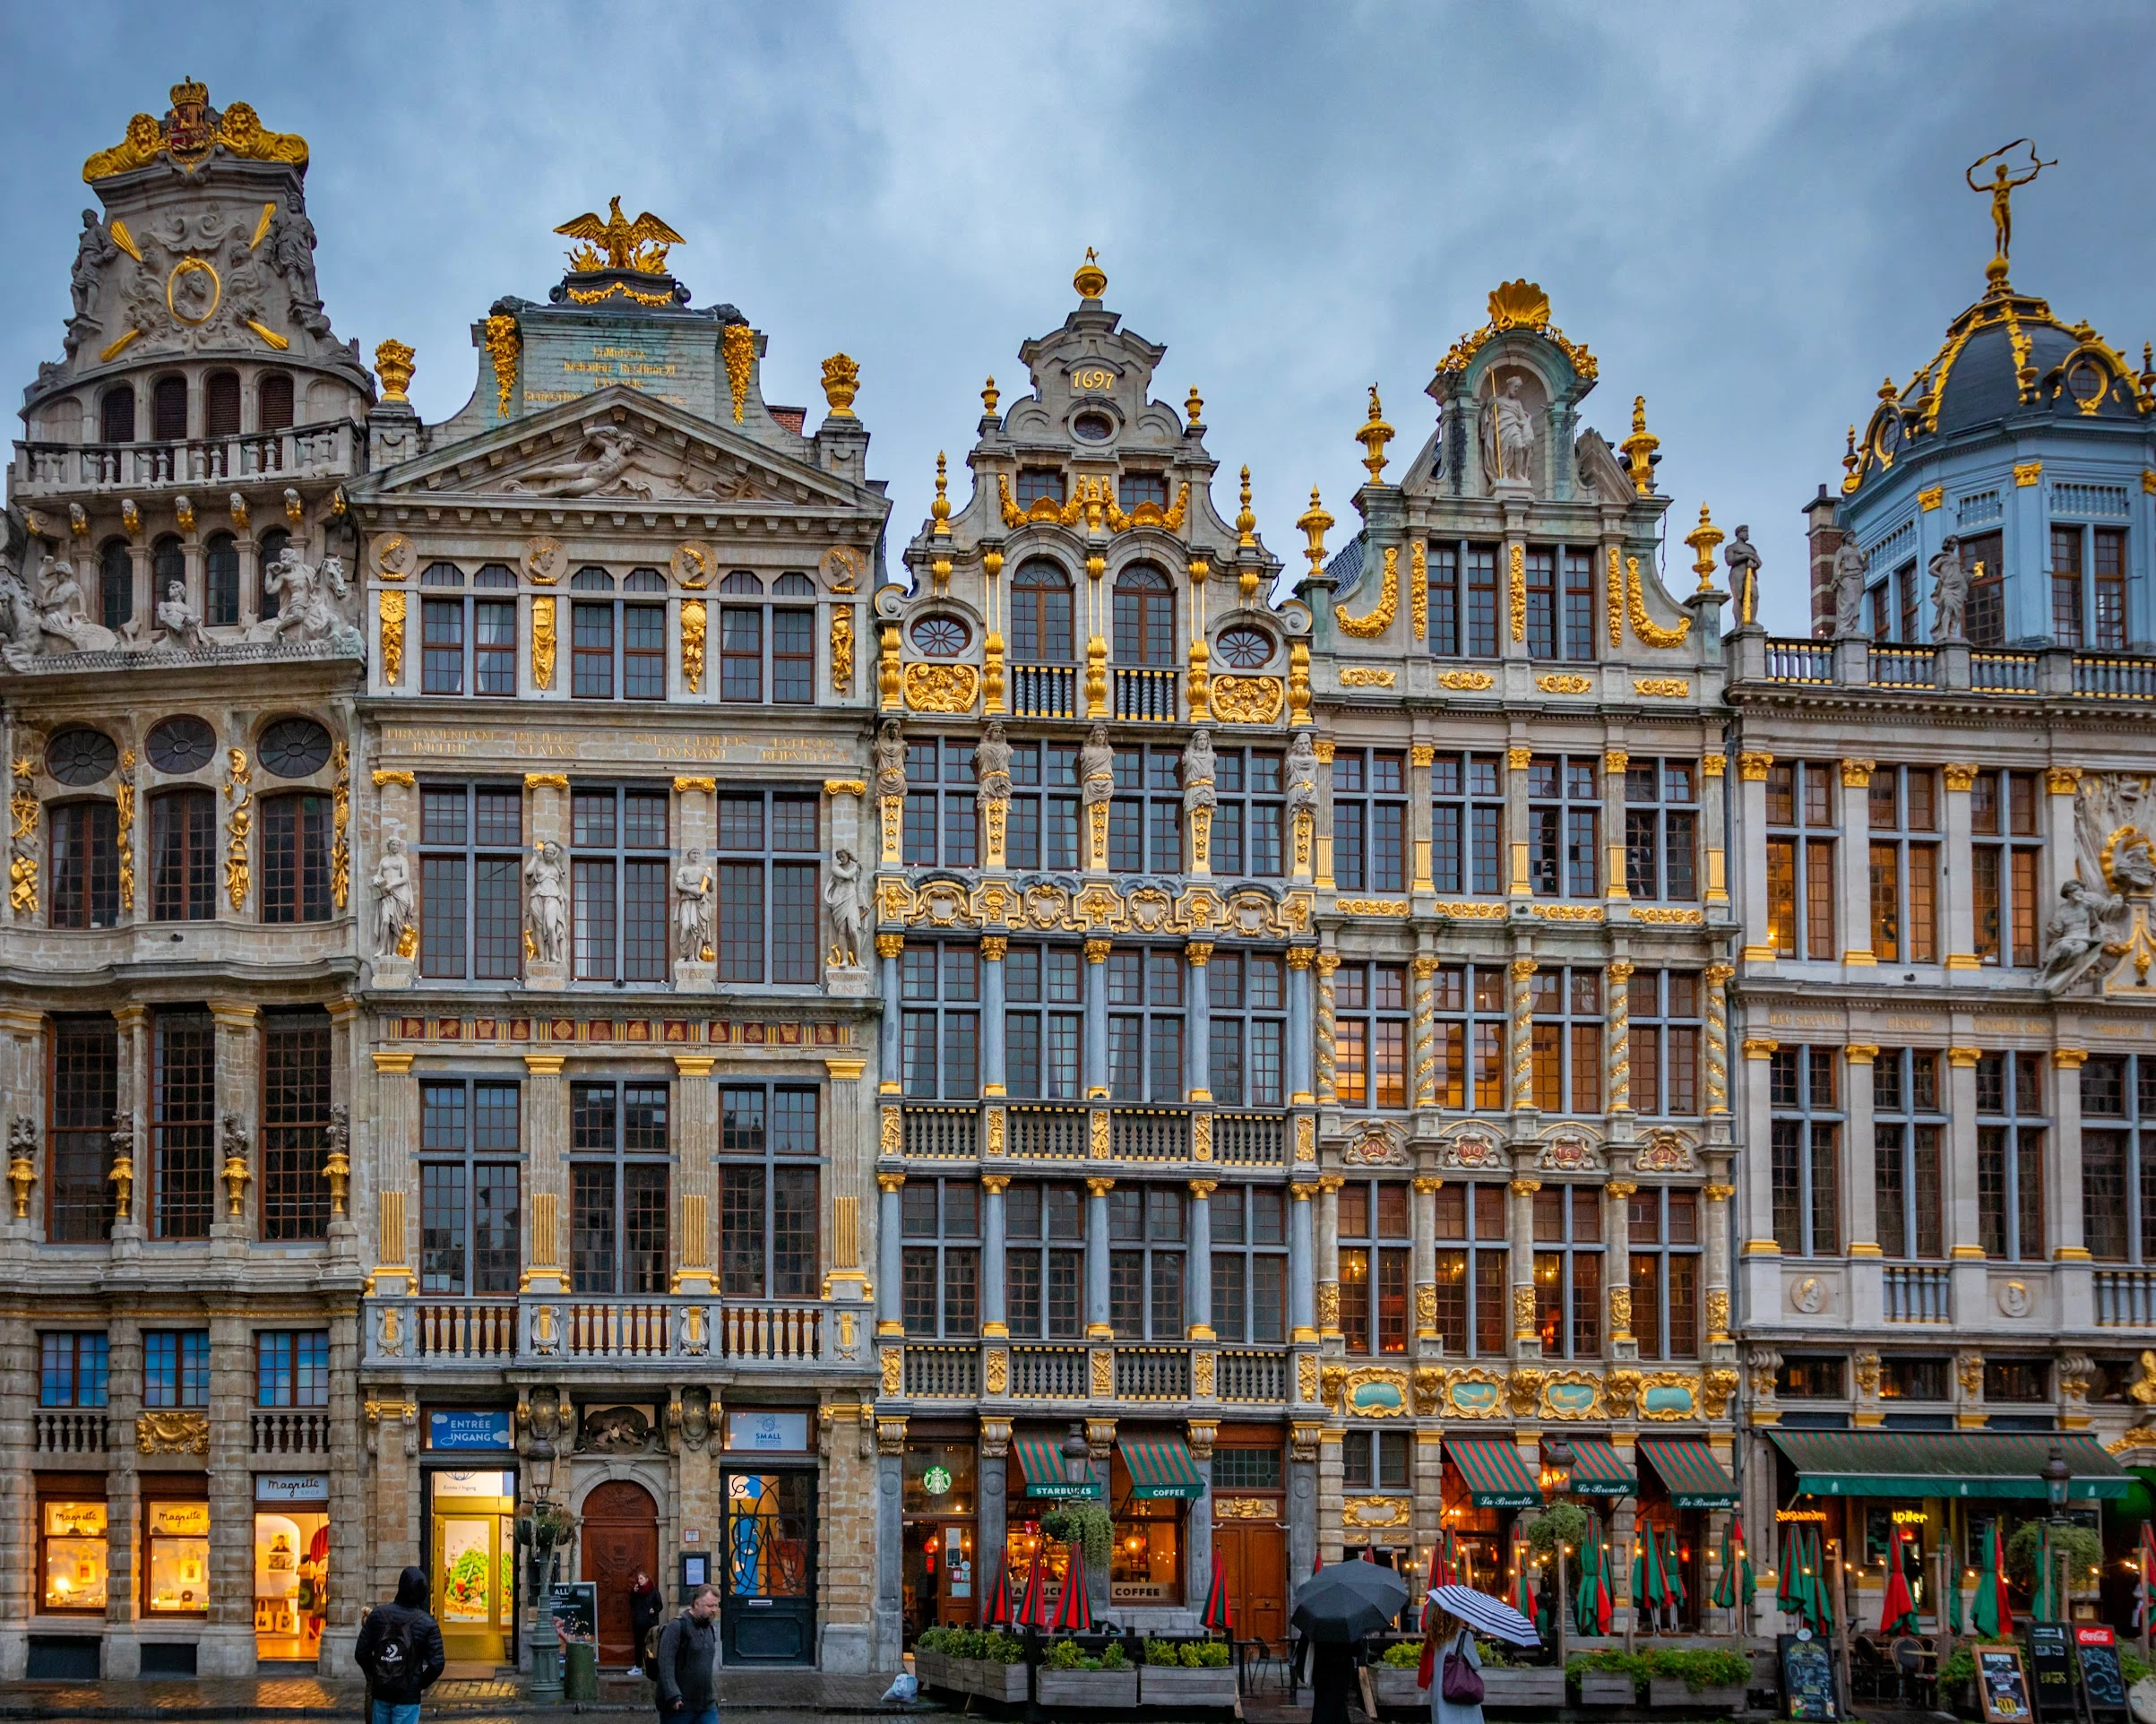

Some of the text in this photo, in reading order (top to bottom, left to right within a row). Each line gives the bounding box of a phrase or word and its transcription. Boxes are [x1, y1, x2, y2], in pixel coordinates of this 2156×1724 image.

[1073, 370, 1115, 390] 1697
[658, 747, 726, 760] HVMANI
[681, 969, 707, 978] PAX
[450, 1418, 491, 1428] ENTRÉE
[450, 1433, 491, 1442] INGANG
[267, 1478, 320, 1497] Magritte
[1152, 1488, 1186, 1496] COFFEE
[1577, 1484, 1591, 1494] La
[1479, 1496, 1494, 1505] La
[55, 1511, 97, 1526] Magritte
[159, 1510, 202, 1527] Magritte
[1893, 1510, 1928, 1524] upiler
[1115, 1588, 1160, 1597] COFFEE
